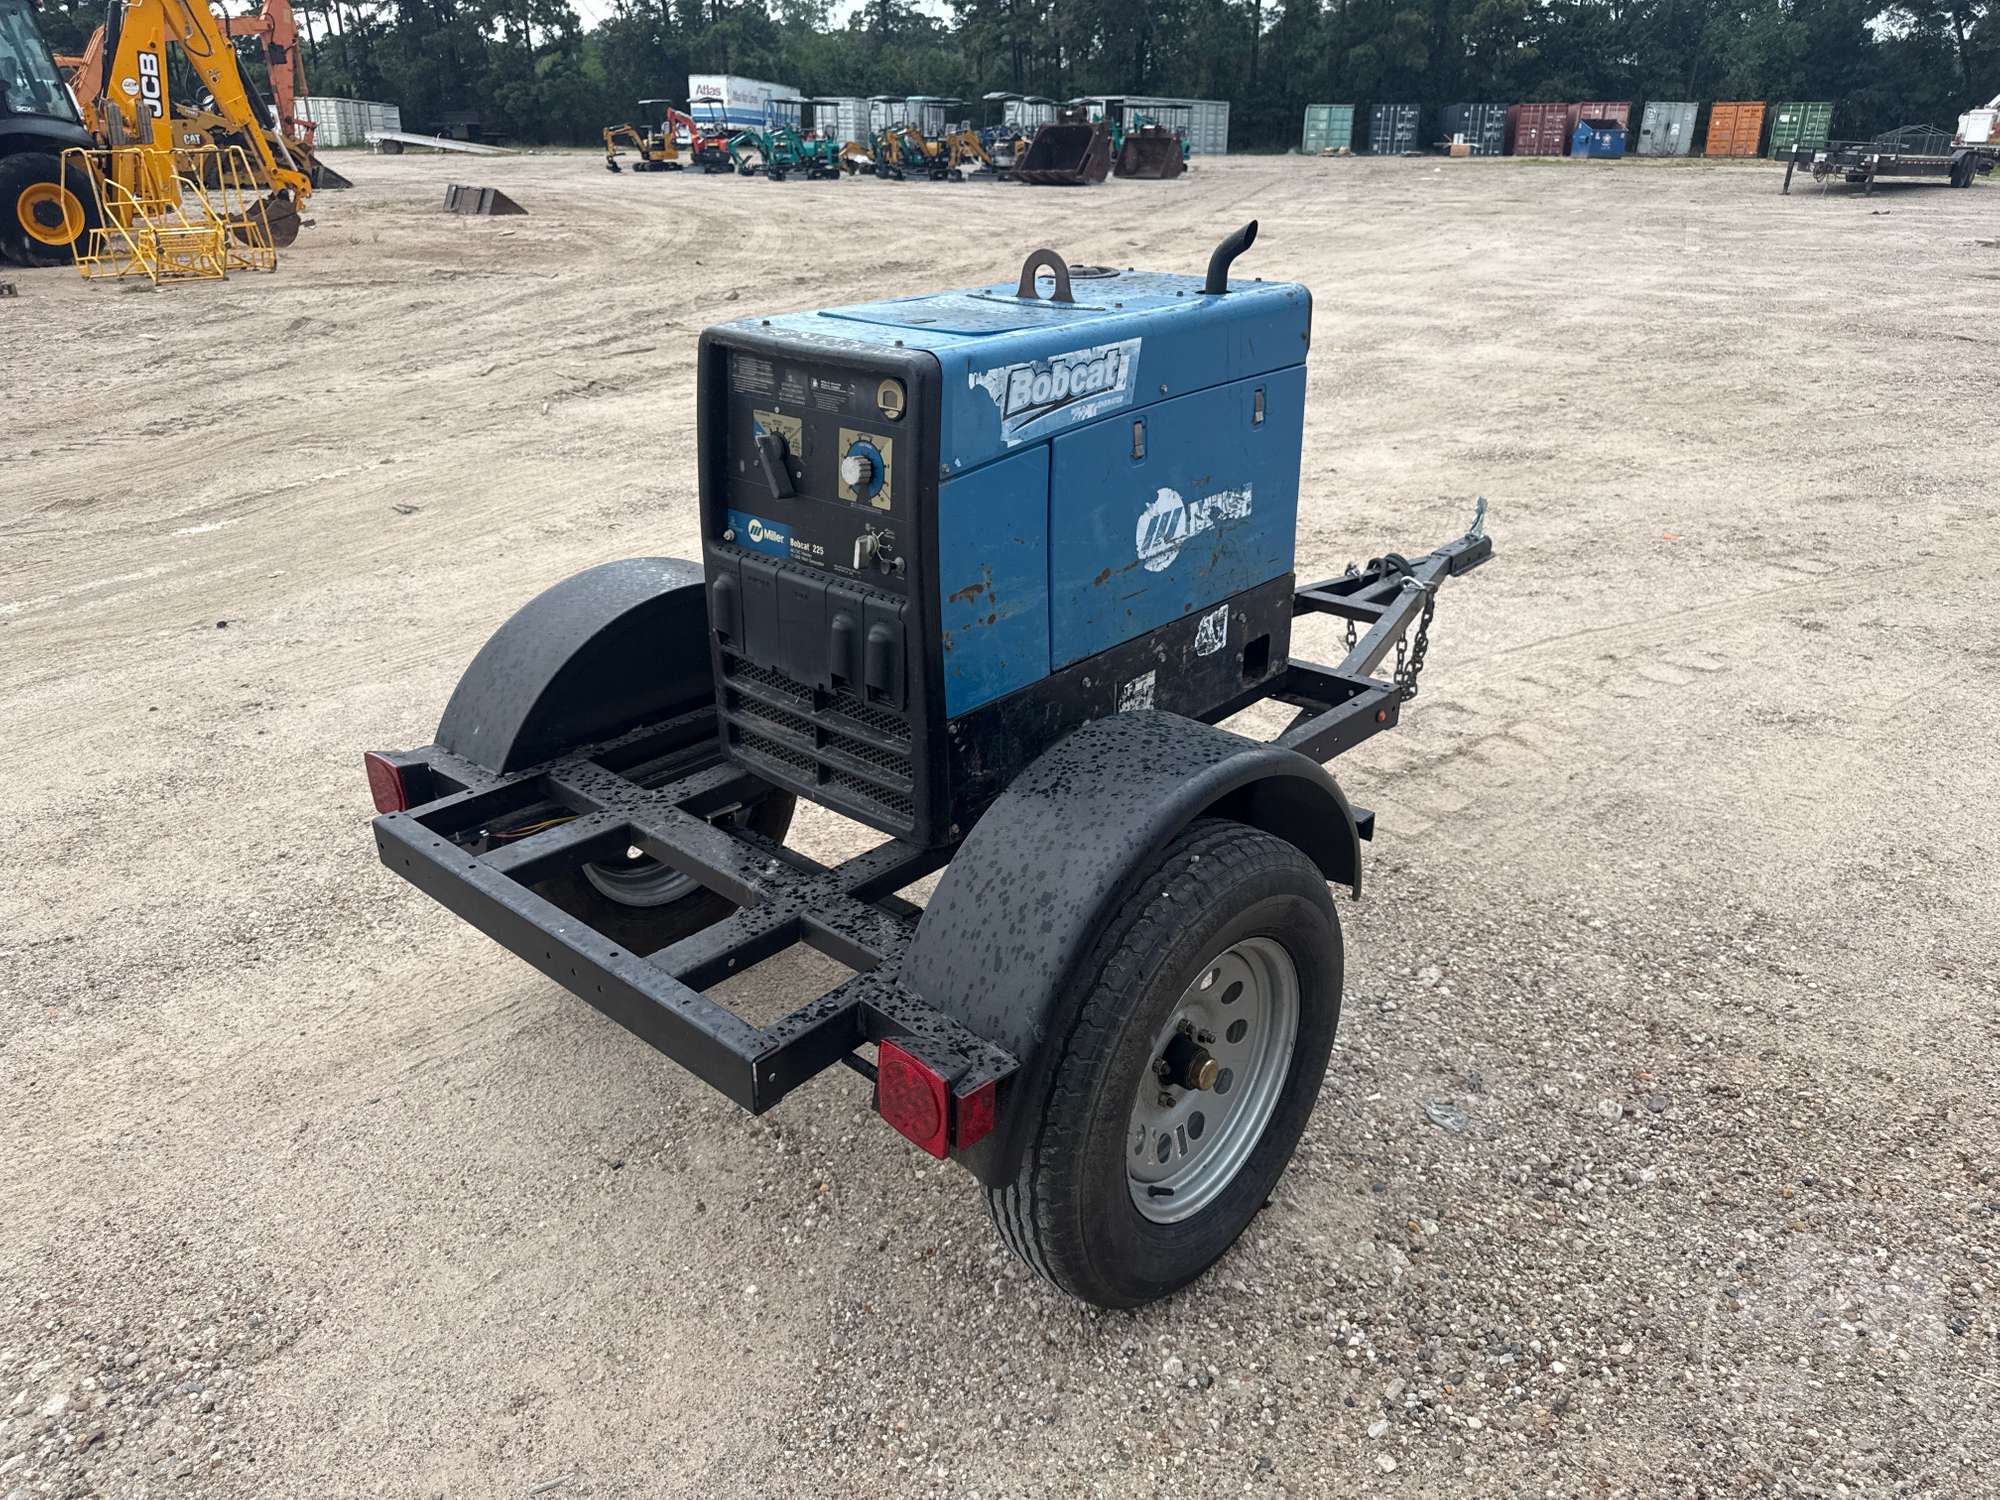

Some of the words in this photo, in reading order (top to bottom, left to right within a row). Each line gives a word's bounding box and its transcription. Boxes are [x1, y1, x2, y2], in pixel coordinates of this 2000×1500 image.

[139, 53, 163, 118] JCB
[696, 84, 722, 97] Atlas
[183, 134, 201, 145] CAT
[1007, 348, 1121, 412] Bobcat
[764, 528, 785, 544] Miller
[789, 537, 810, 552] Bobcat
[812, 544, 825, 556] 225
